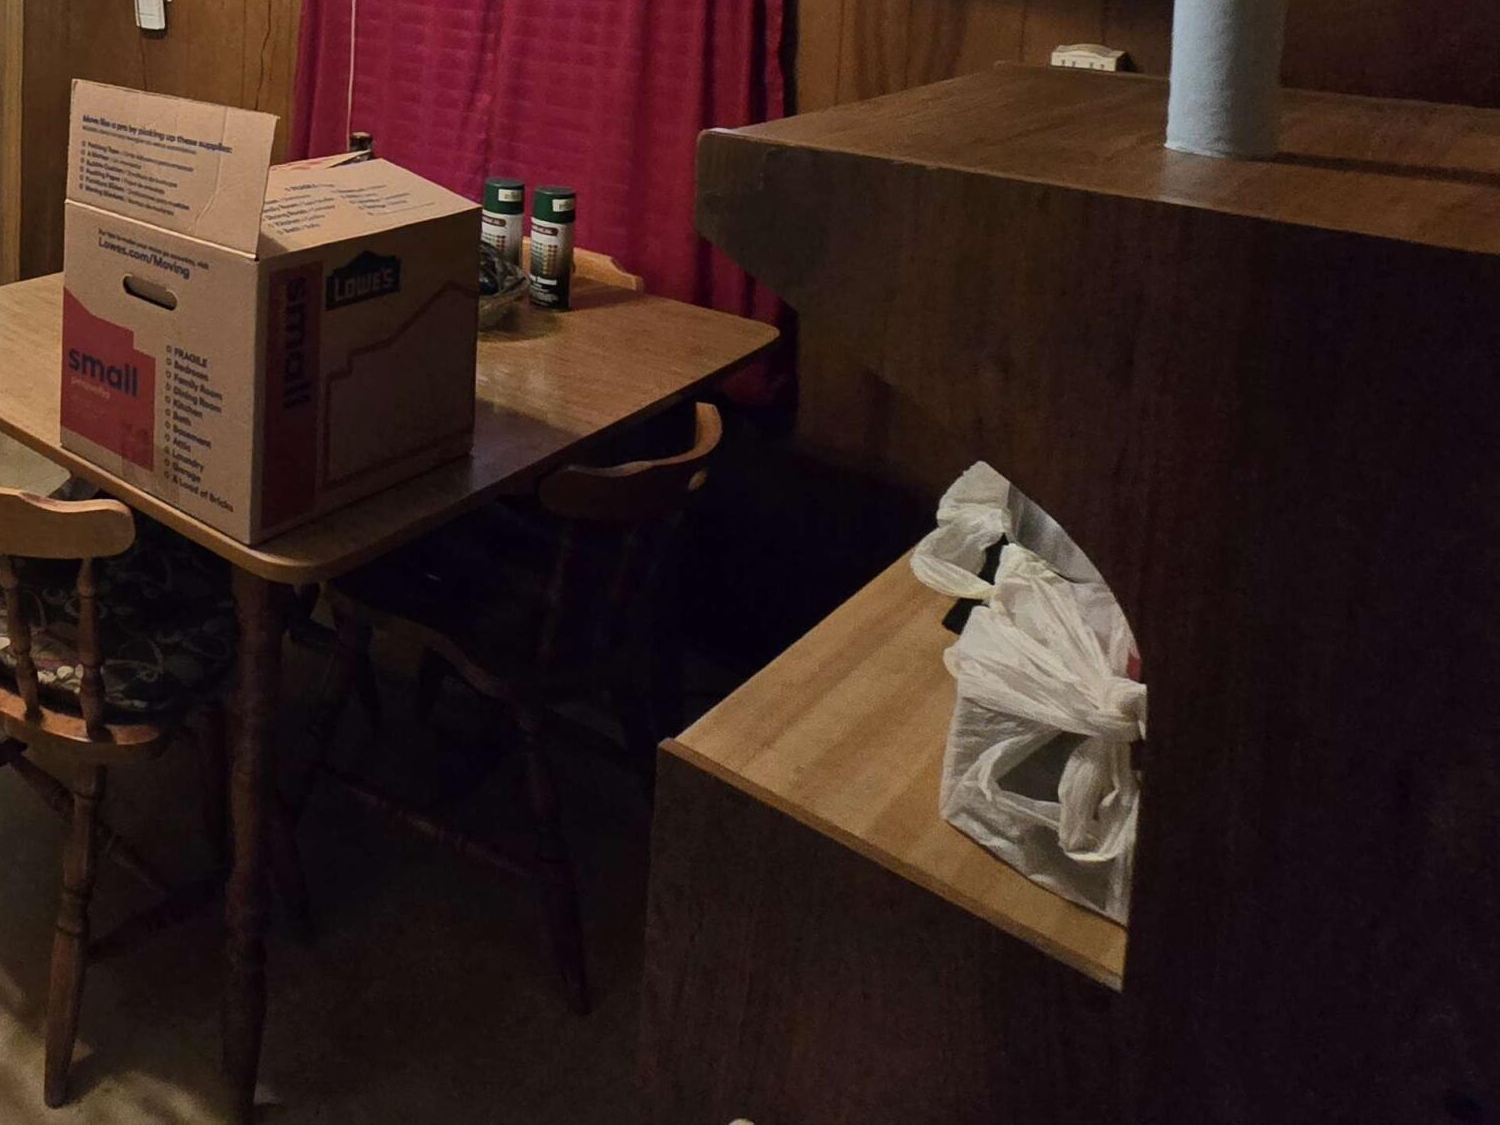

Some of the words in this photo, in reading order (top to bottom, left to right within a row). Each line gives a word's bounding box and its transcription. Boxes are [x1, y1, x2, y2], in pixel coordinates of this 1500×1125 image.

[98, 236, 190, 280] Lowes.com/Moving
[334, 267, 394, 301] LOWE'S
[283, 276, 311, 409] small
[174, 347, 207, 368] FRAGILE
[174, 360, 209, 381] Bedroom
[68, 348, 138, 397] small
[173, 386, 198, 405] Dining
[199, 396, 222, 413] Room
[174, 373, 198, 392] Family
[200, 384, 223, 400] Room
[173, 398, 203, 418] Kitchen
[172, 449, 204, 473] Laundry
